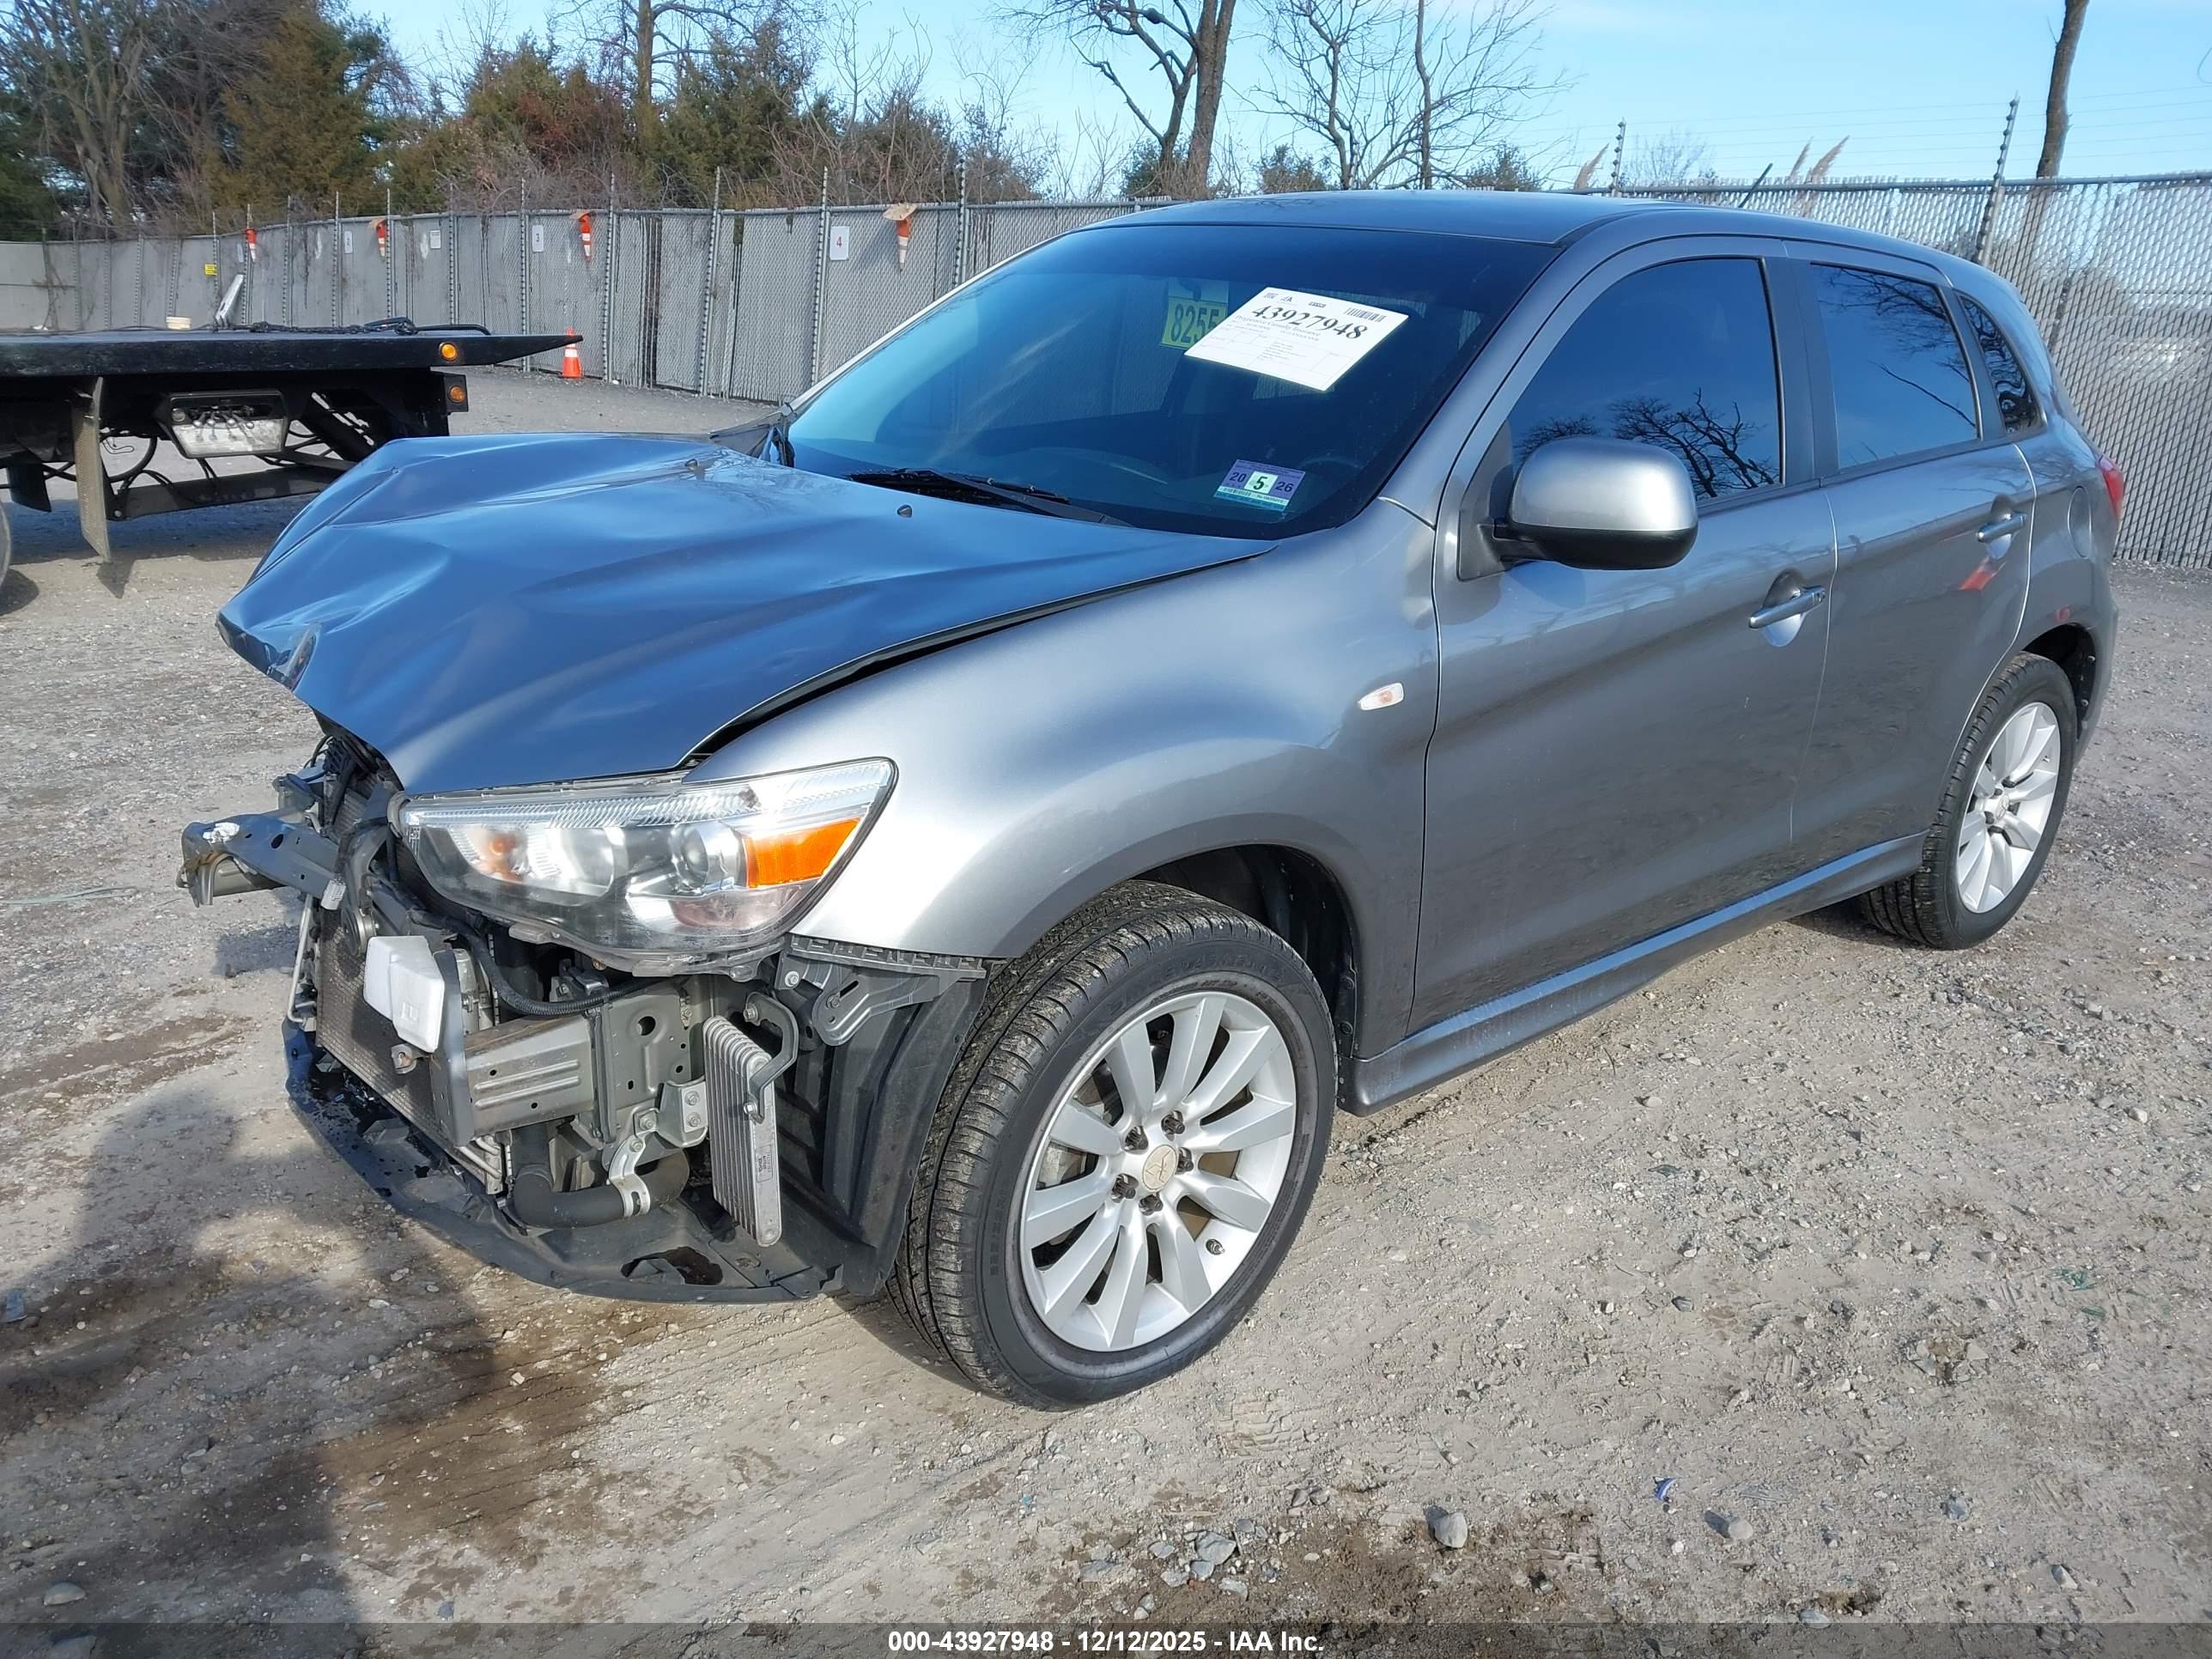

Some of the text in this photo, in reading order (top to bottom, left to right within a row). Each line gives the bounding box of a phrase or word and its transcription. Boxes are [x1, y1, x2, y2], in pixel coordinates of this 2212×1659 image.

[836, 235, 843, 248] 4
[1251, 304, 1368, 340] 43927948
[1229, 471, 1294, 493] 20 5 26
